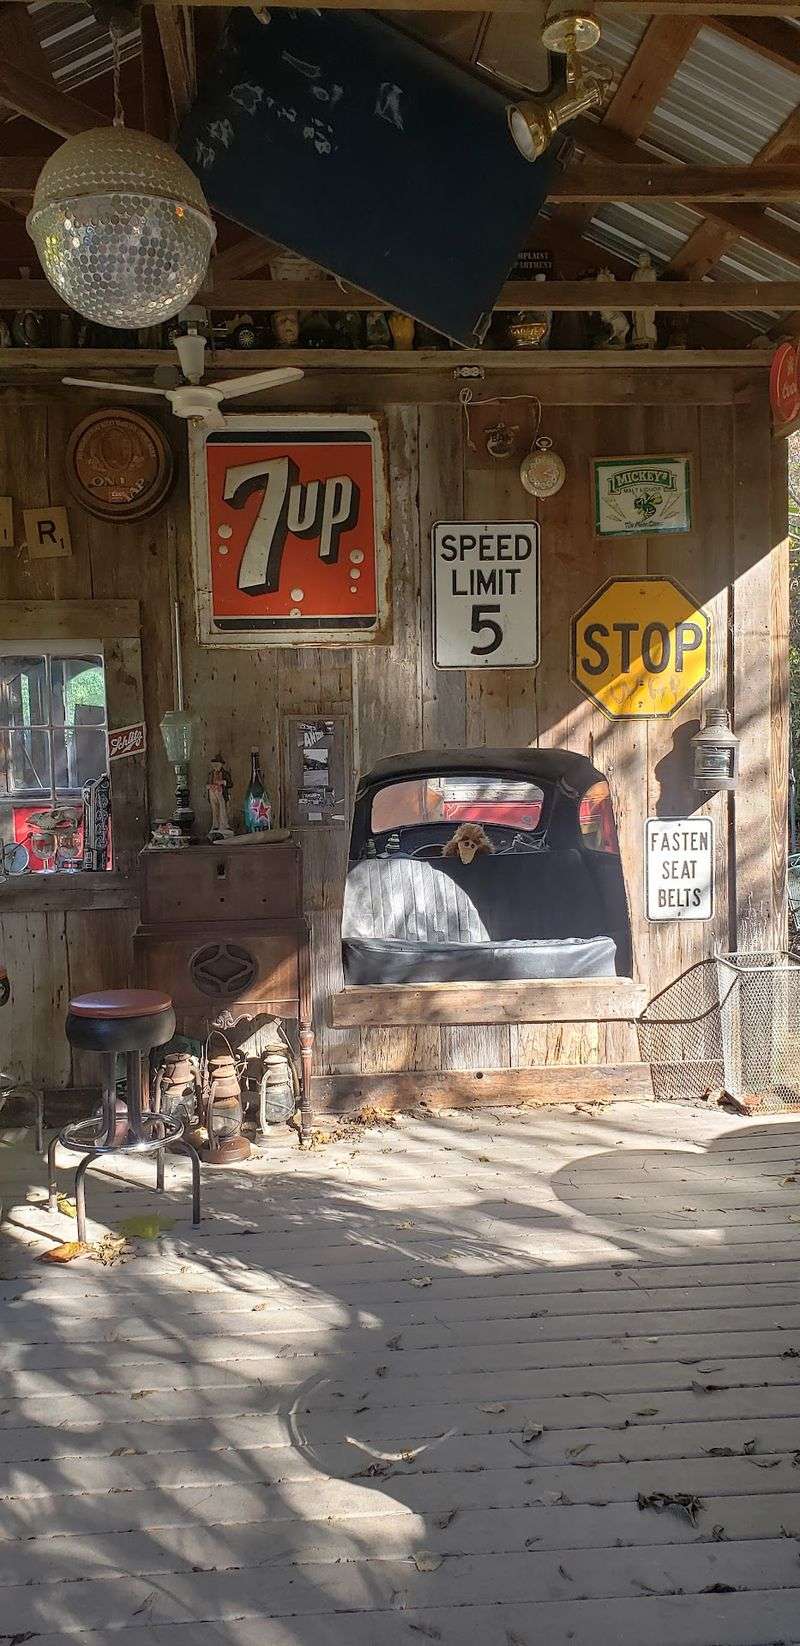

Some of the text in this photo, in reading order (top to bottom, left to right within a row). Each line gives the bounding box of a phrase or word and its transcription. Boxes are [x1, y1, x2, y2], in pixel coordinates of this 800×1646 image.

[440, 534, 533, 562] SPEED
[452, 568, 521, 595] LIMIT
[470, 604, 504, 656] 5
[581, 622, 703, 676] STOP
[111, 730, 143, 756] Schlitz
[651, 832, 708, 851] FASTEN
[662, 860, 697, 880] SEAT
[658, 888, 702, 908] BELTS
